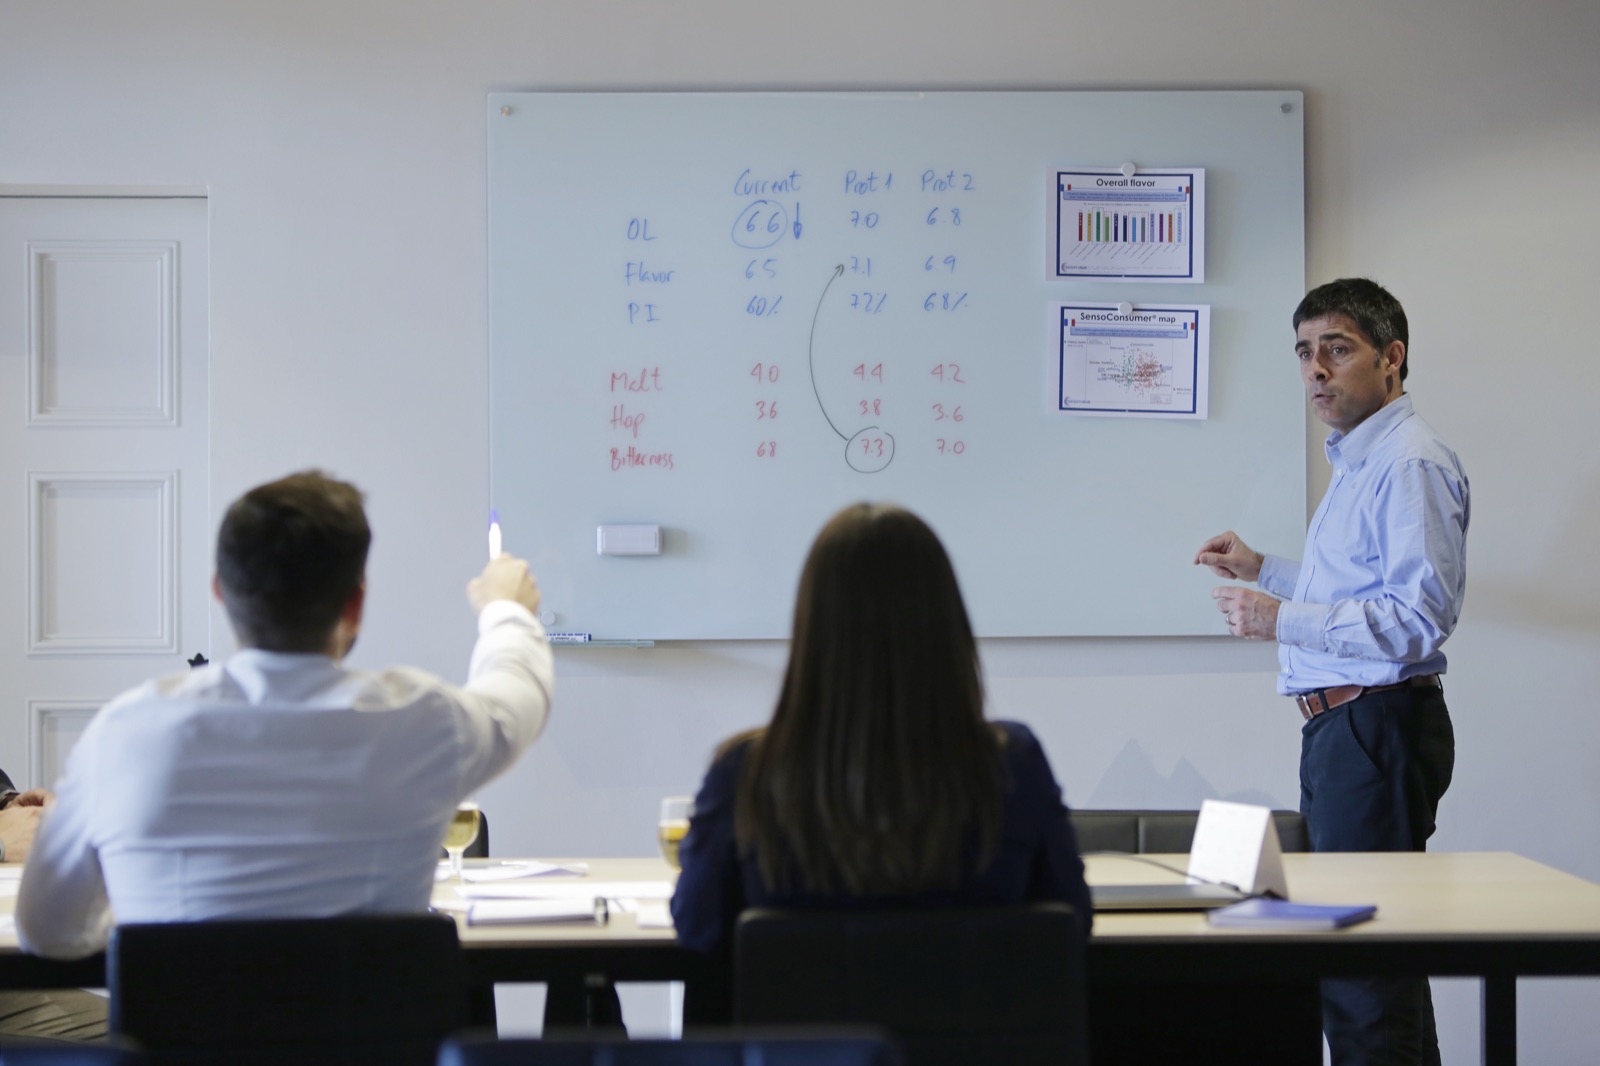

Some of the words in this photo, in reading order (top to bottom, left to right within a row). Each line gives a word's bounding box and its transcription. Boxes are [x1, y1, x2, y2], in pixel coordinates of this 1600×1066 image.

[733, 167, 802, 197] Current
[844, 169, 880, 196] Prot
[920, 168, 956, 193] Prot
[961, 173, 975, 192] 2
[1096, 178, 1128, 187] Overall
[1130, 178, 1156, 187] flavor
[626, 217, 657, 242] OL
[623, 260, 675, 287] Flavor
[745, 295, 783, 317] 60%
[850, 291, 888, 315] 72%
[923, 291, 968, 312] 68%
[1158, 315, 1176, 323] map
[610, 366, 663, 393] Malt
[609, 403, 646, 440] Hop
[609, 445, 675, 472] Bitterness
